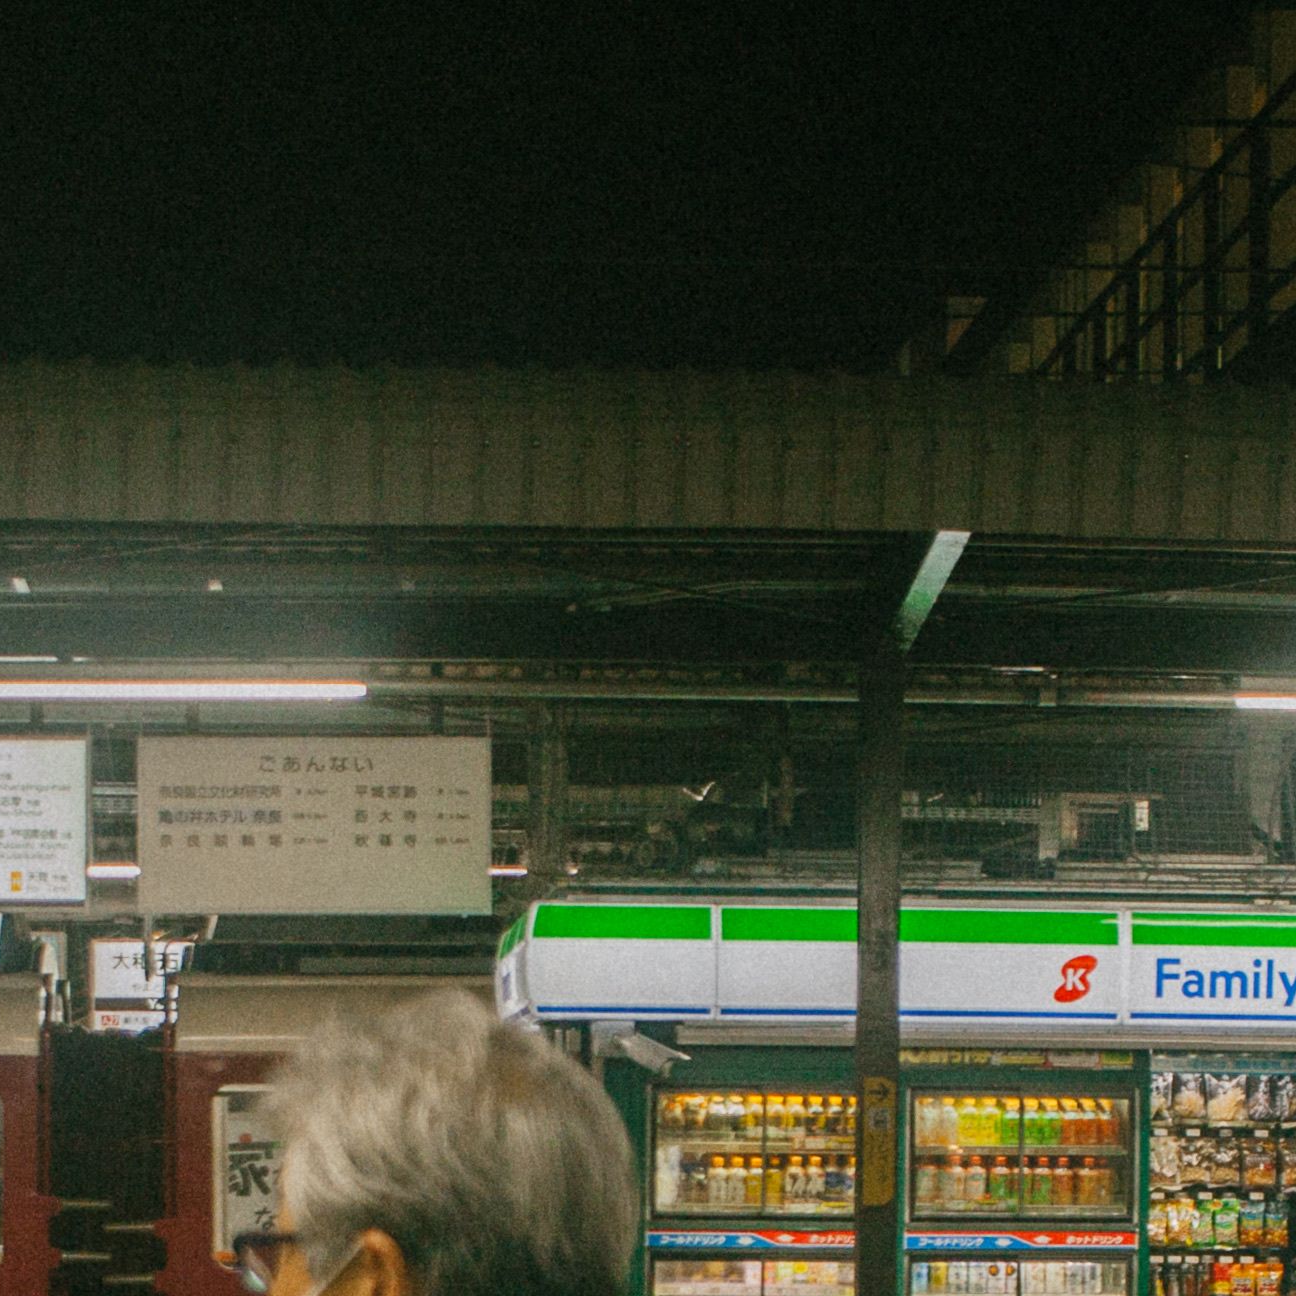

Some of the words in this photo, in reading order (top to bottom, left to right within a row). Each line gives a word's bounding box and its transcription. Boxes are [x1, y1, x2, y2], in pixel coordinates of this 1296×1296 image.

[660, 1234, 726, 1246] コールドドリンク
[918, 1237, 984, 1247] コールドドリンク
[1066, 1235, 1124, 1245] ホットドリンク
